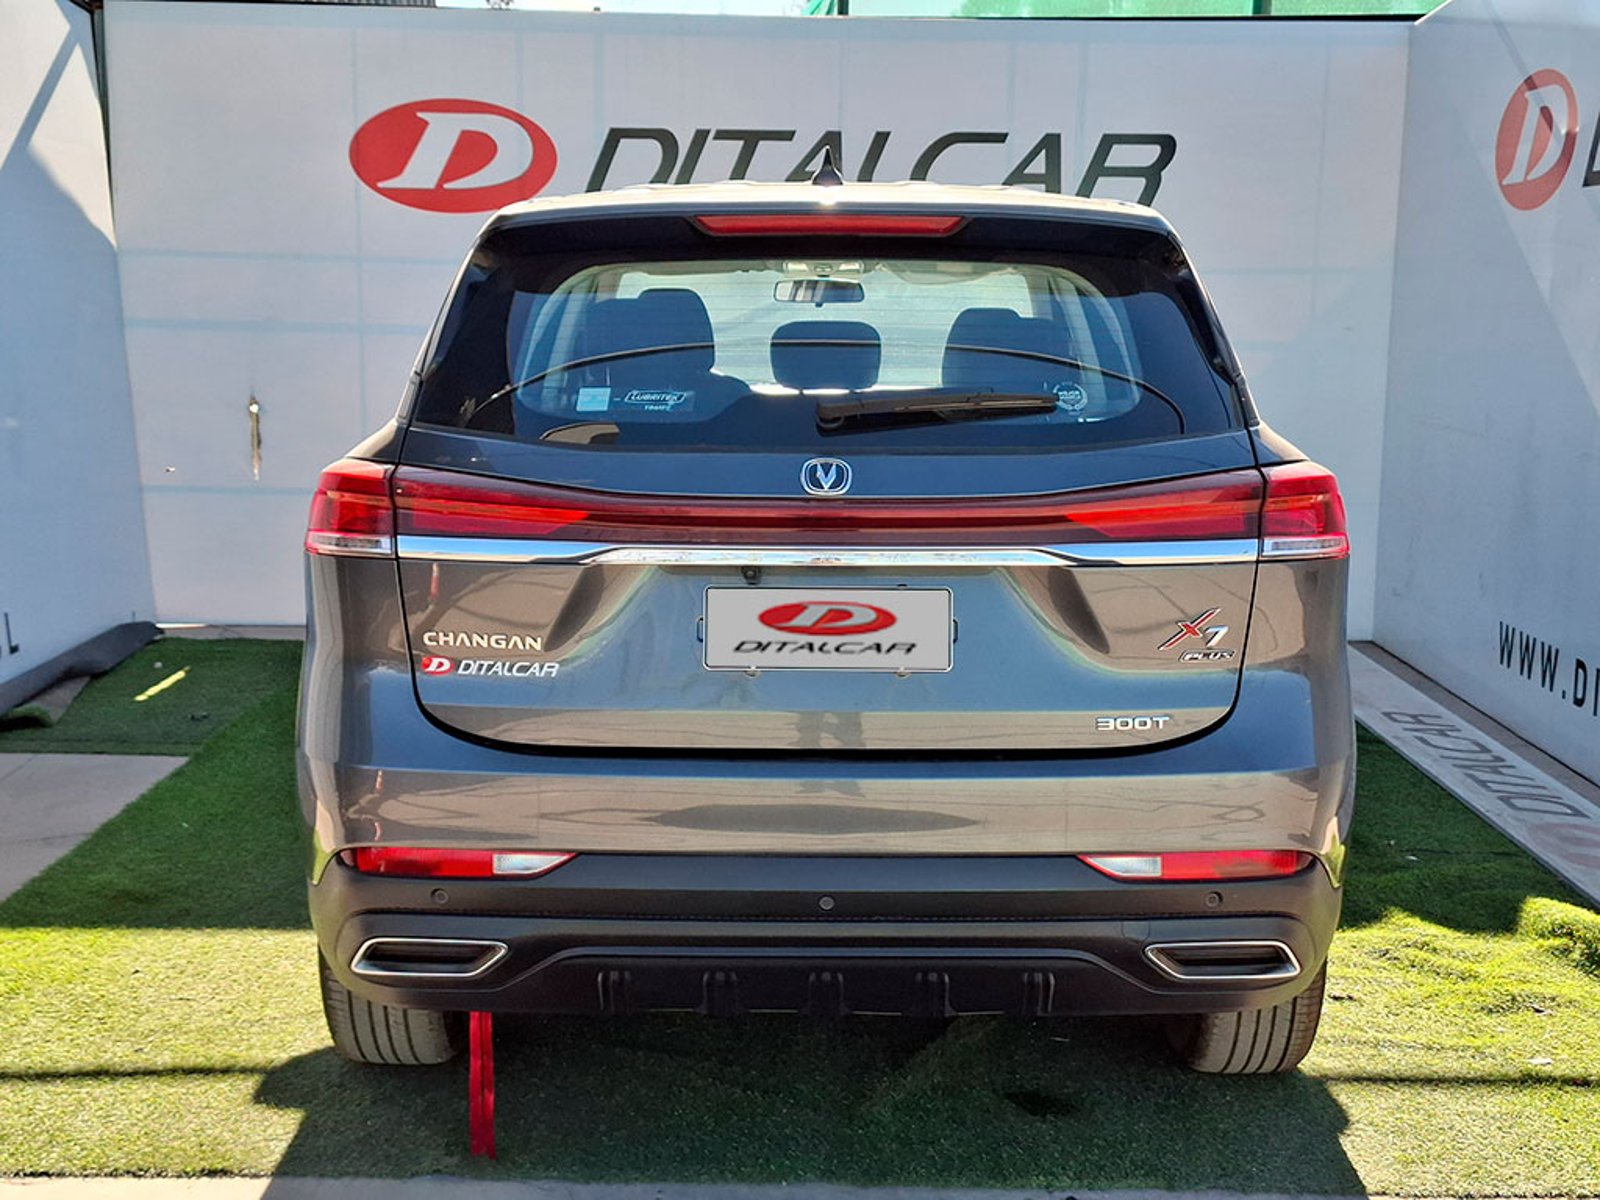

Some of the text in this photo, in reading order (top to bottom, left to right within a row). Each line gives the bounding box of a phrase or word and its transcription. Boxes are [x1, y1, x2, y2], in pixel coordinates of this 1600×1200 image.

[584, 127, 1178, 208] DITALCAR
[1157, 607, 1230, 651] X7
[422, 631, 543, 651] CHANGAN
[457, 659, 560, 677] DITALCAR
[1096, 716, 1170, 732] 300T
